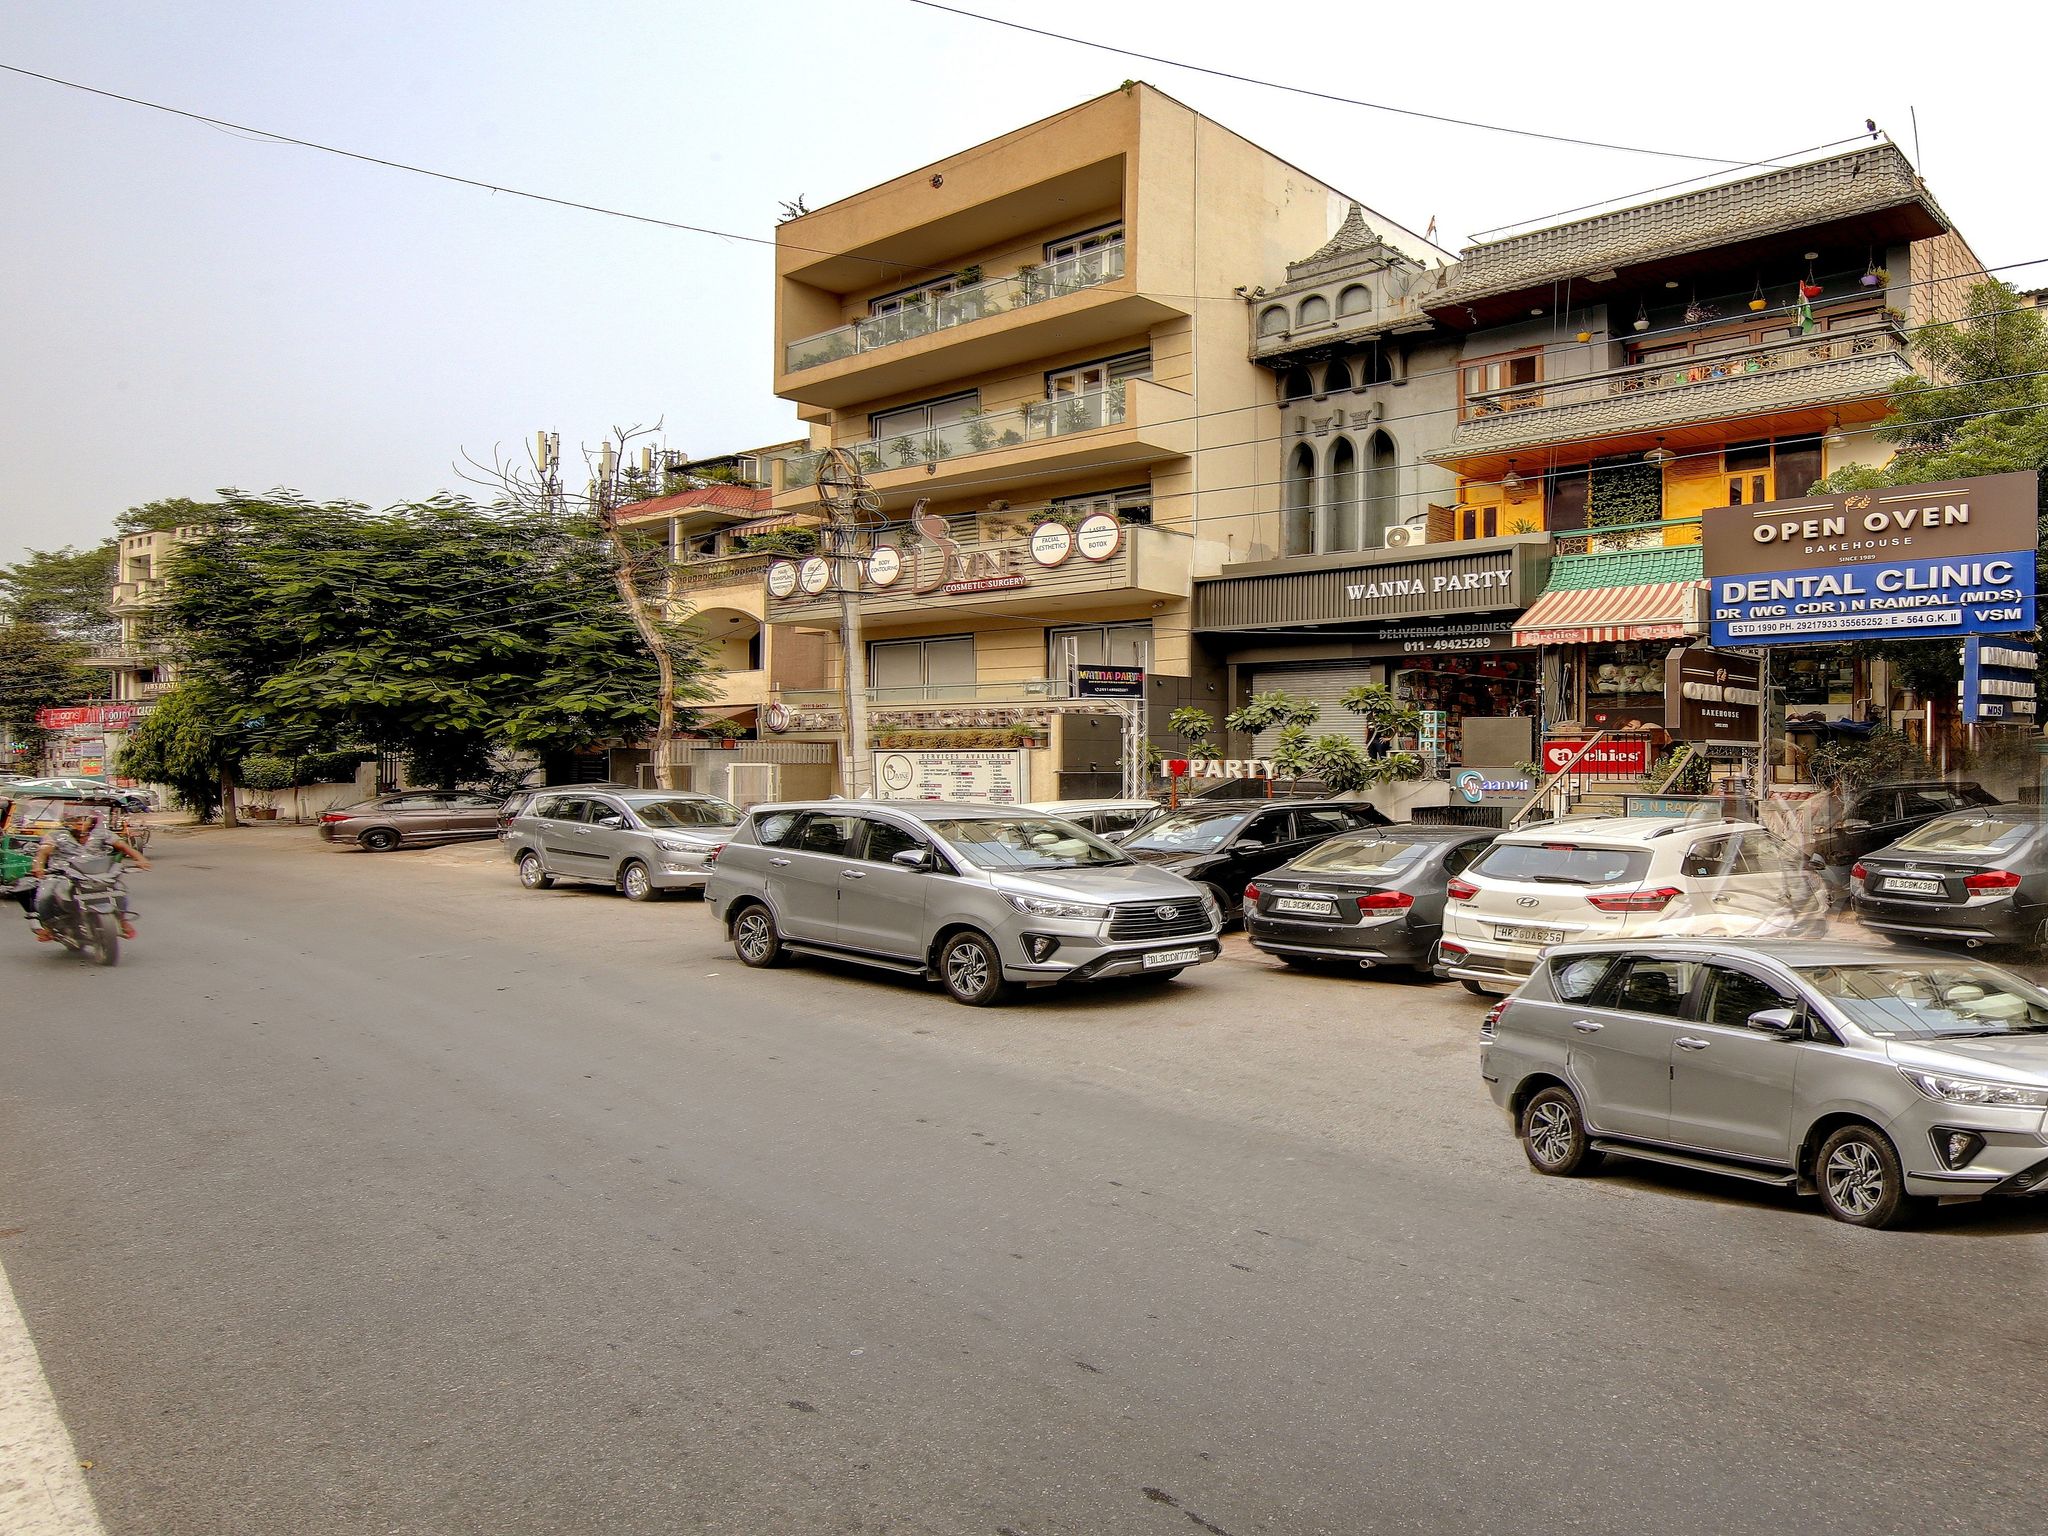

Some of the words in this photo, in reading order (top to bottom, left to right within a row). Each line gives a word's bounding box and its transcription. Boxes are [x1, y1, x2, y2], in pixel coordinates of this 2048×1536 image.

[1753, 516, 1846, 543] OPEN
[1863, 503, 1970, 532] OVEN
[1035, 543, 1067, 552] AESTHETICS
[1088, 540, 1108, 548] BOTOX
[1804, 537, 1913, 554] BAKEHOUSE
[945, 581, 988, 593] COSMETIC
[988, 577, 1025, 588] SURGERY
[1346, 578, 1426, 600] WANNA
[1433, 569, 1513, 593] PARTY
[1722, 573, 1867, 604] DENTAL
[1875, 561, 2014, 592] CLINIC
[1716, 607, 1742, 620] DR
[1749, 605, 1787, 619] (WG
[1794, 601, 1835, 614] CDR
[1851, 600, 1866, 611] N
[1869, 594, 1956, 609] RAMPAL
[1960, 589, 2023, 607] (MDS)
[1974, 608, 2023, 622] VSM
[1732, 623, 1755, 633] ESTD
[1758, 622, 1777, 632] 1990
[1779, 621, 1795, 631] PH.
[1796, 619, 1838, 629] 29217933
[1840, 617, 1883, 628] 35565252
[1891, 616, 1898, 625] E
[1907, 615, 1924, 624] 564
[1926, 613, 1948, 623] G.K.
[1379, 625, 1445, 640] DELIVERING
[1404, 641, 1424, 651] 011
[1433, 637, 1491, 650] 49425289
[159, 682, 180, 690] DENTA
[1701, 708, 1740, 719] BAKEHOUSE
[1188, 759, 1277, 780] PARTY
[1631, 801, 1646, 813] Dr.
[1649, 801, 1662, 813] N.
[1665, 801, 1716, 814] RAMPA
